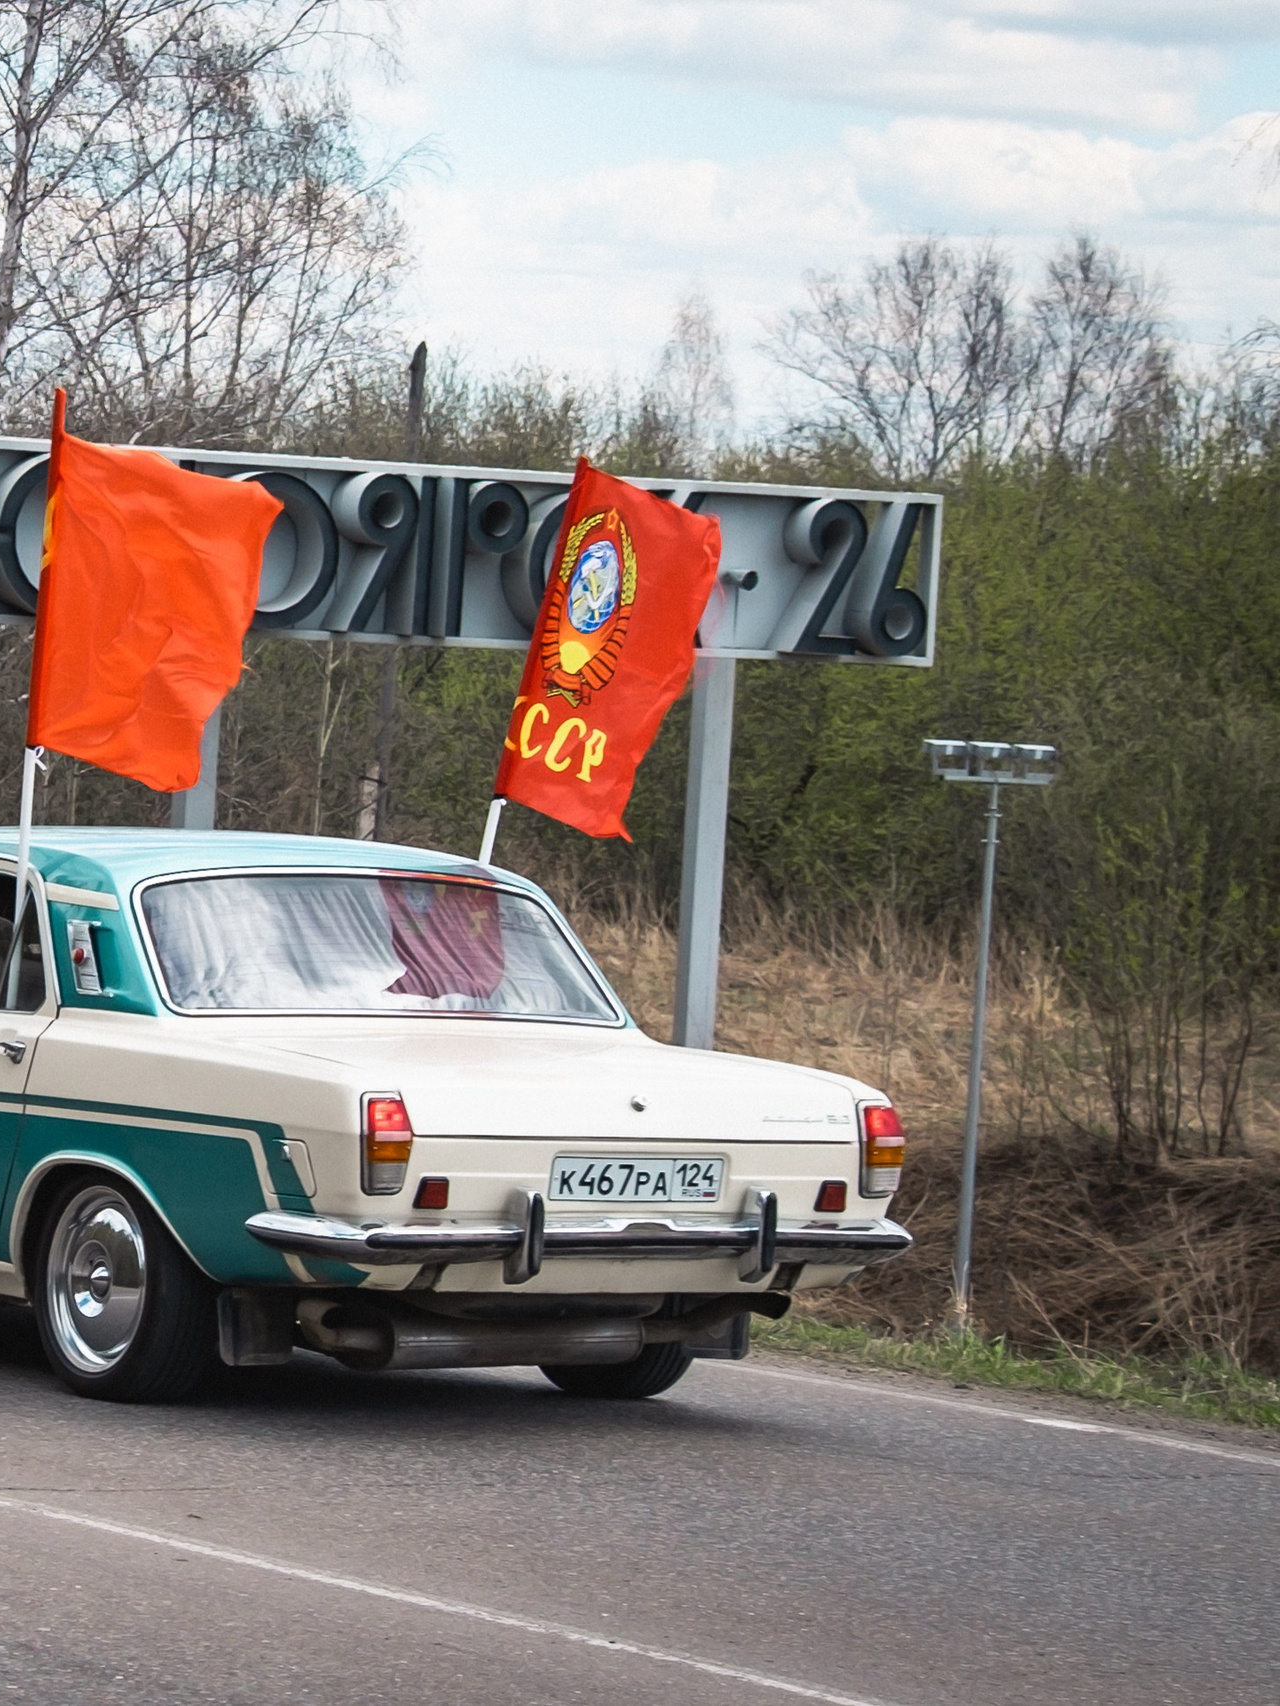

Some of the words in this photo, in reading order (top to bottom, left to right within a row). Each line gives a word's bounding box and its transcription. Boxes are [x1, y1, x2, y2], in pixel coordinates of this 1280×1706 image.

[504, 695, 608, 783] ССР
[558, 1163, 668, 1197] К467РА
[676, 1163, 715, 1188] 124
[681, 1188, 701, 1197] RUS
